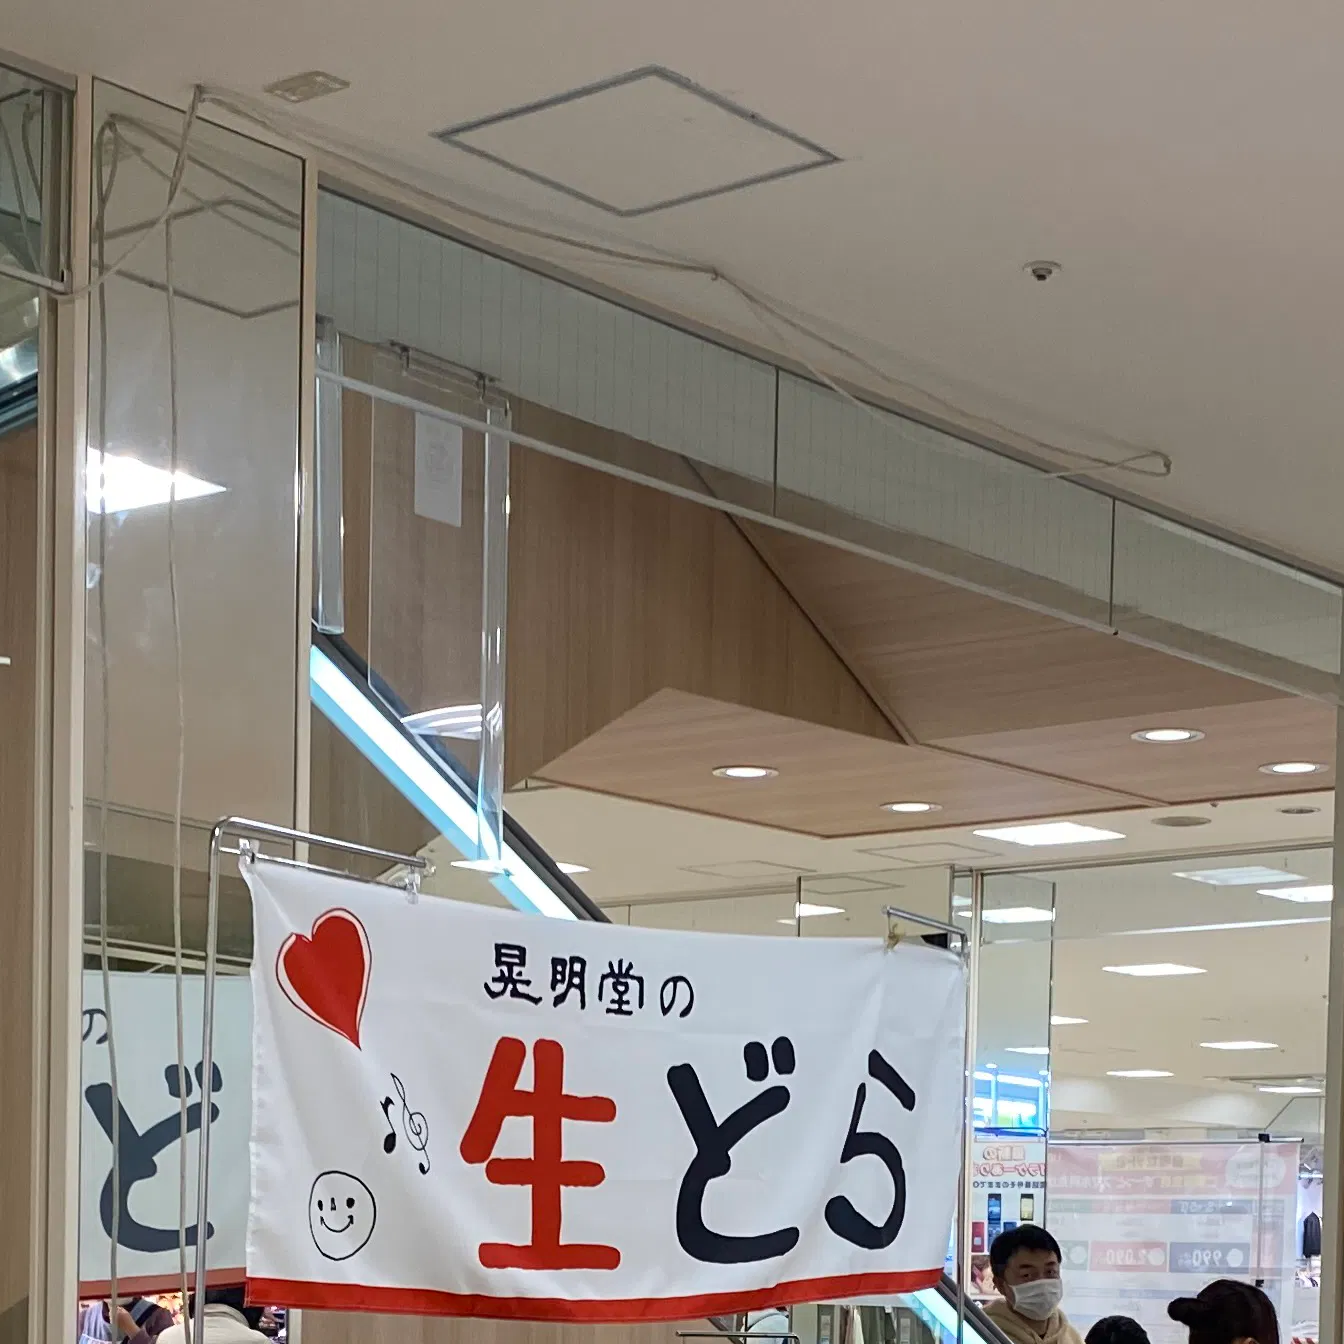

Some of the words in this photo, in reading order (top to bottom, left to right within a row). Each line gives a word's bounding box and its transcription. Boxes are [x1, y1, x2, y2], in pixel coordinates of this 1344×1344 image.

[484, 942, 696, 1018] 晃明堂の
[459, 1036, 916, 1270] 生どら
